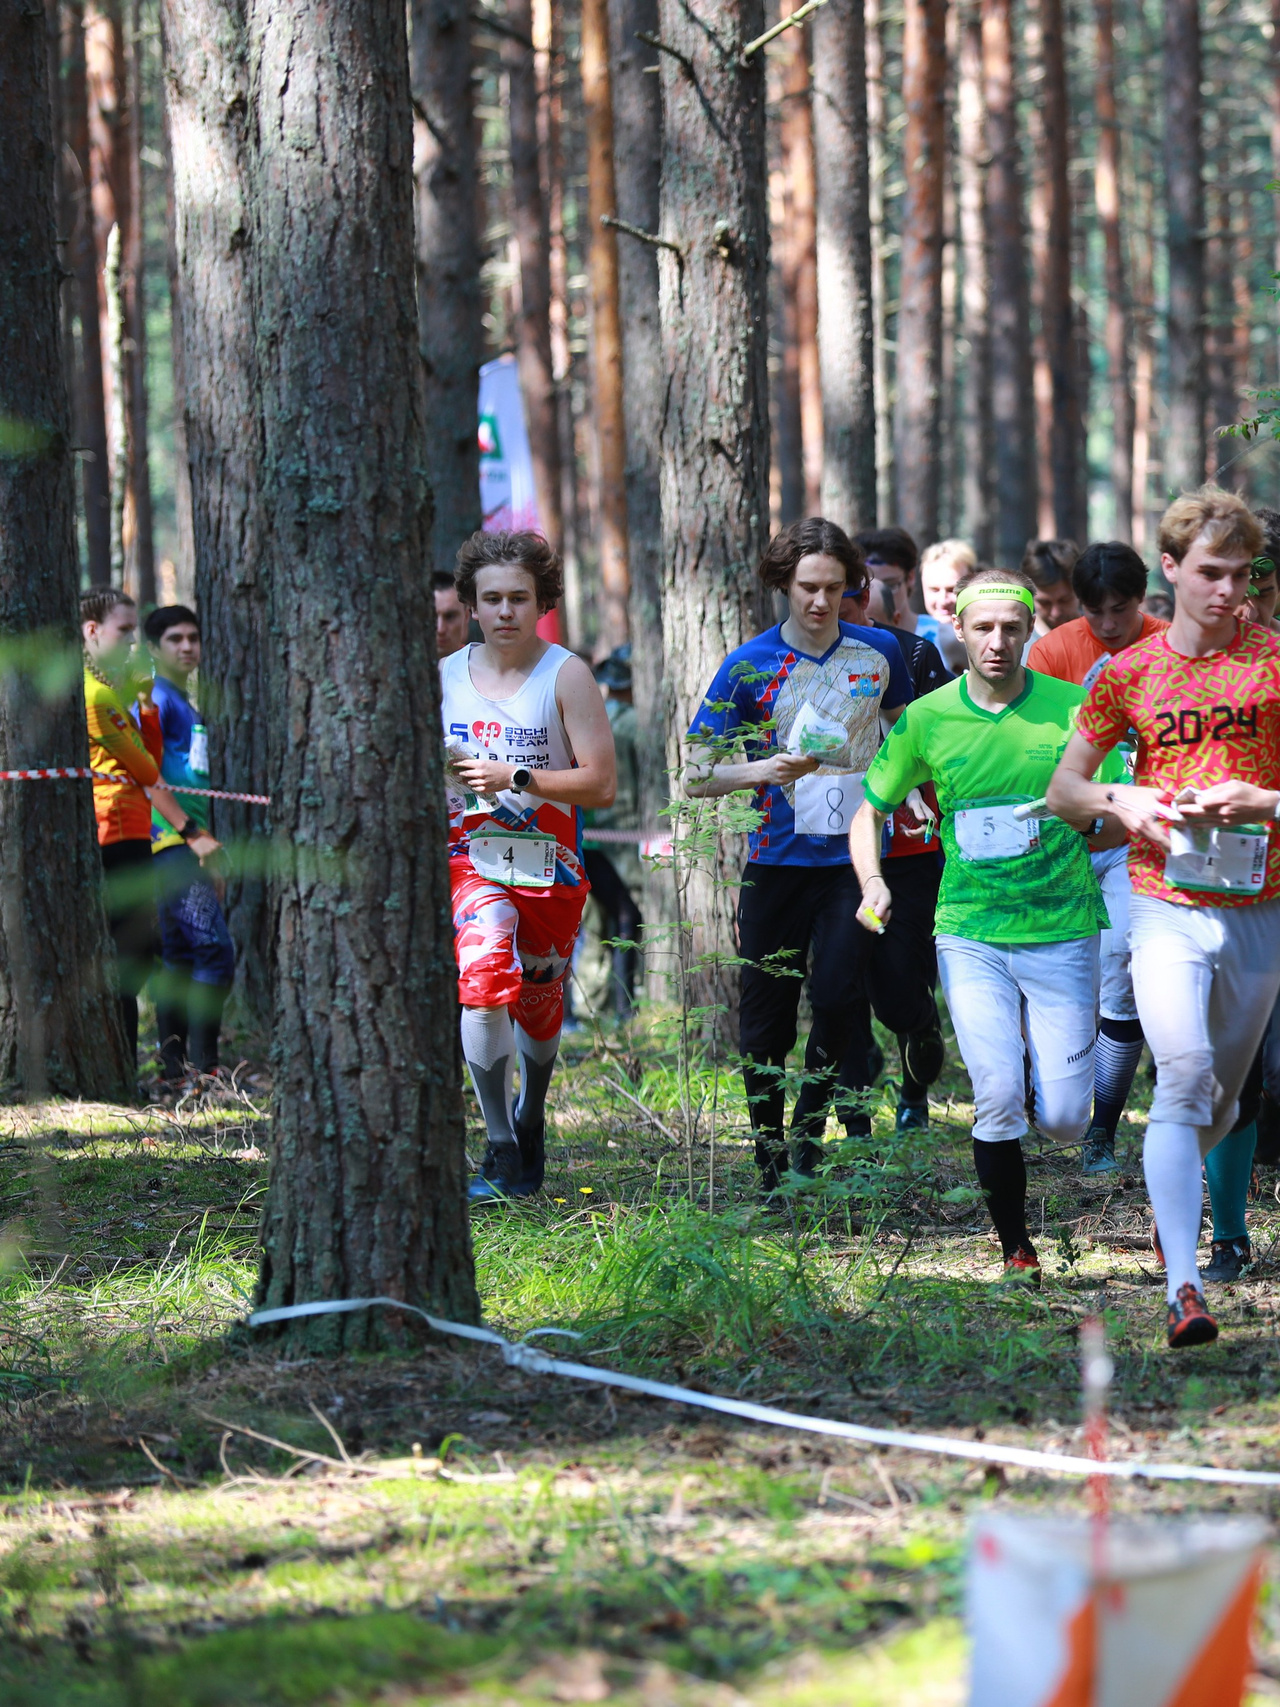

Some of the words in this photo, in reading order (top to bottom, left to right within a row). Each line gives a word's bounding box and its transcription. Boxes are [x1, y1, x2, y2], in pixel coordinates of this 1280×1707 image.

[505, 727, 548, 735] SOCHI
[505, 739, 548, 747] TEAM
[506, 754, 550, 763] ГОРЫ
[826, 787, 844, 829] 8
[983, 816, 995, 835] 5
[503, 846, 514, 863] 4
